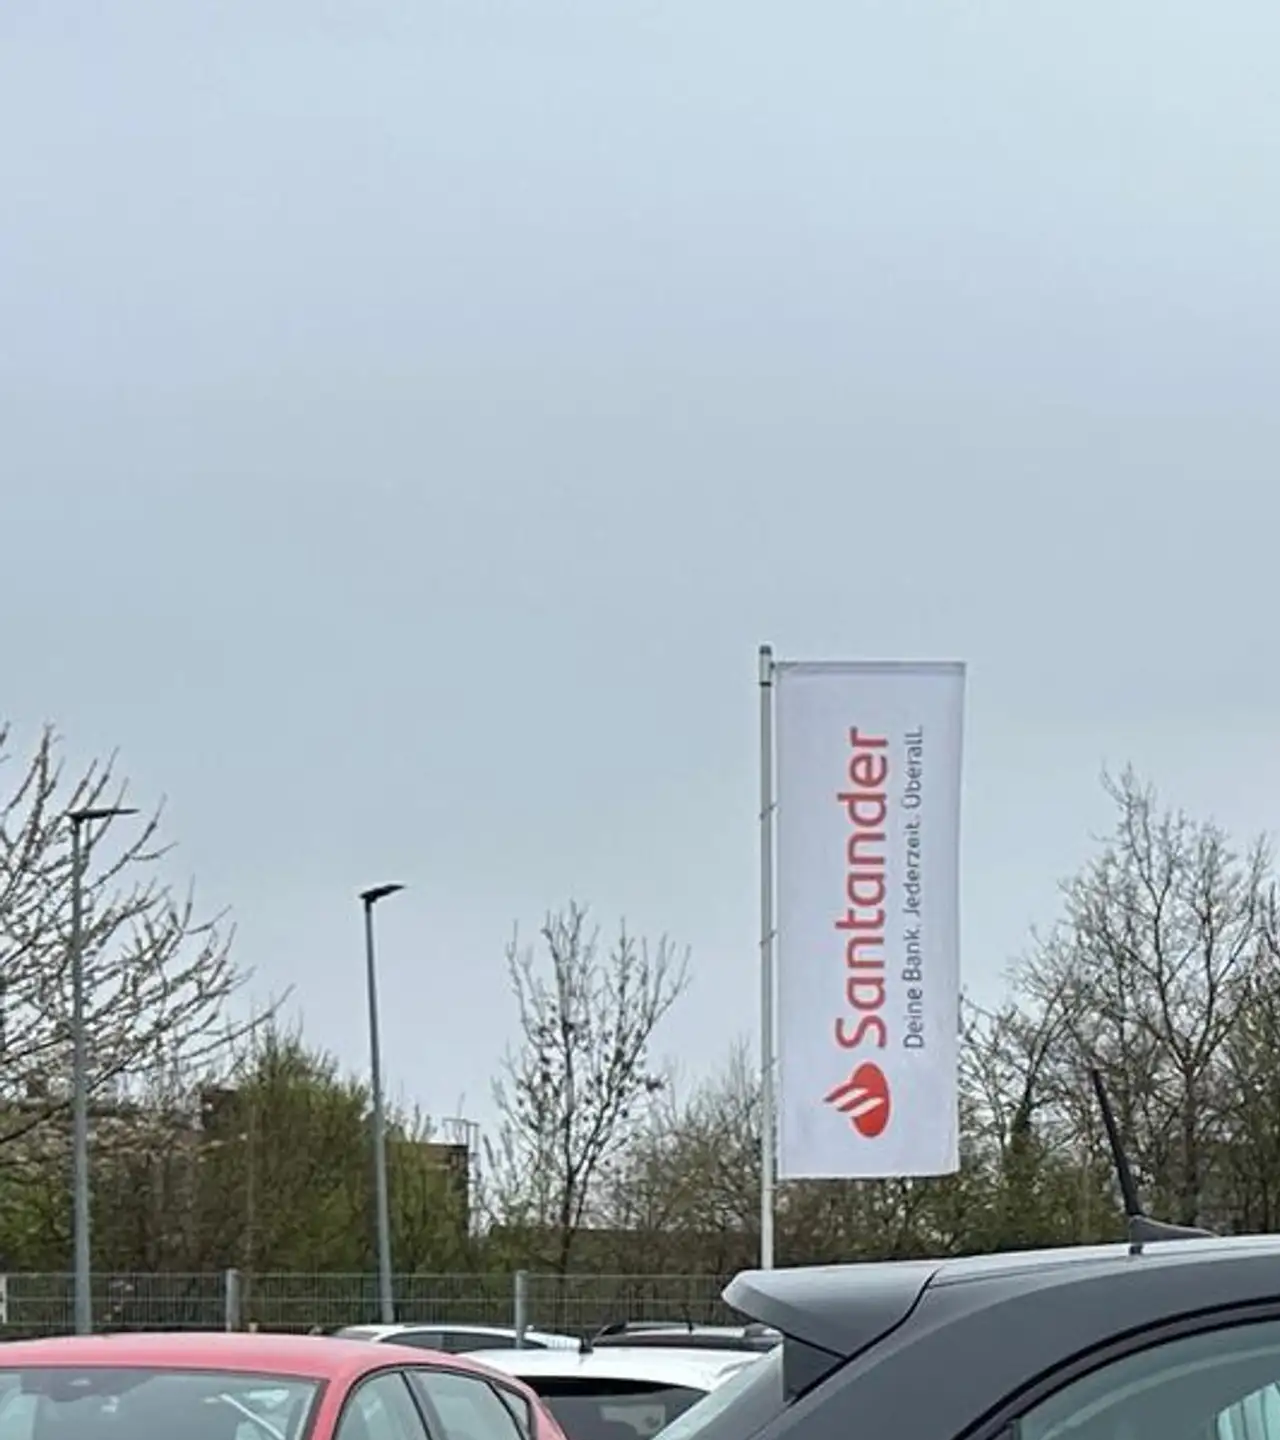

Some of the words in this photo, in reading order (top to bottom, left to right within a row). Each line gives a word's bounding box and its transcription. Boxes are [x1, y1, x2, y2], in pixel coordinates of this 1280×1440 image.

[901, 724, 923, 810] Überall.
[834, 726, 889, 1049] Santander
[902, 815, 922, 917] Jederzeit.
[902, 924, 923, 982] Bank.
[902, 987, 924, 1049] Deine
